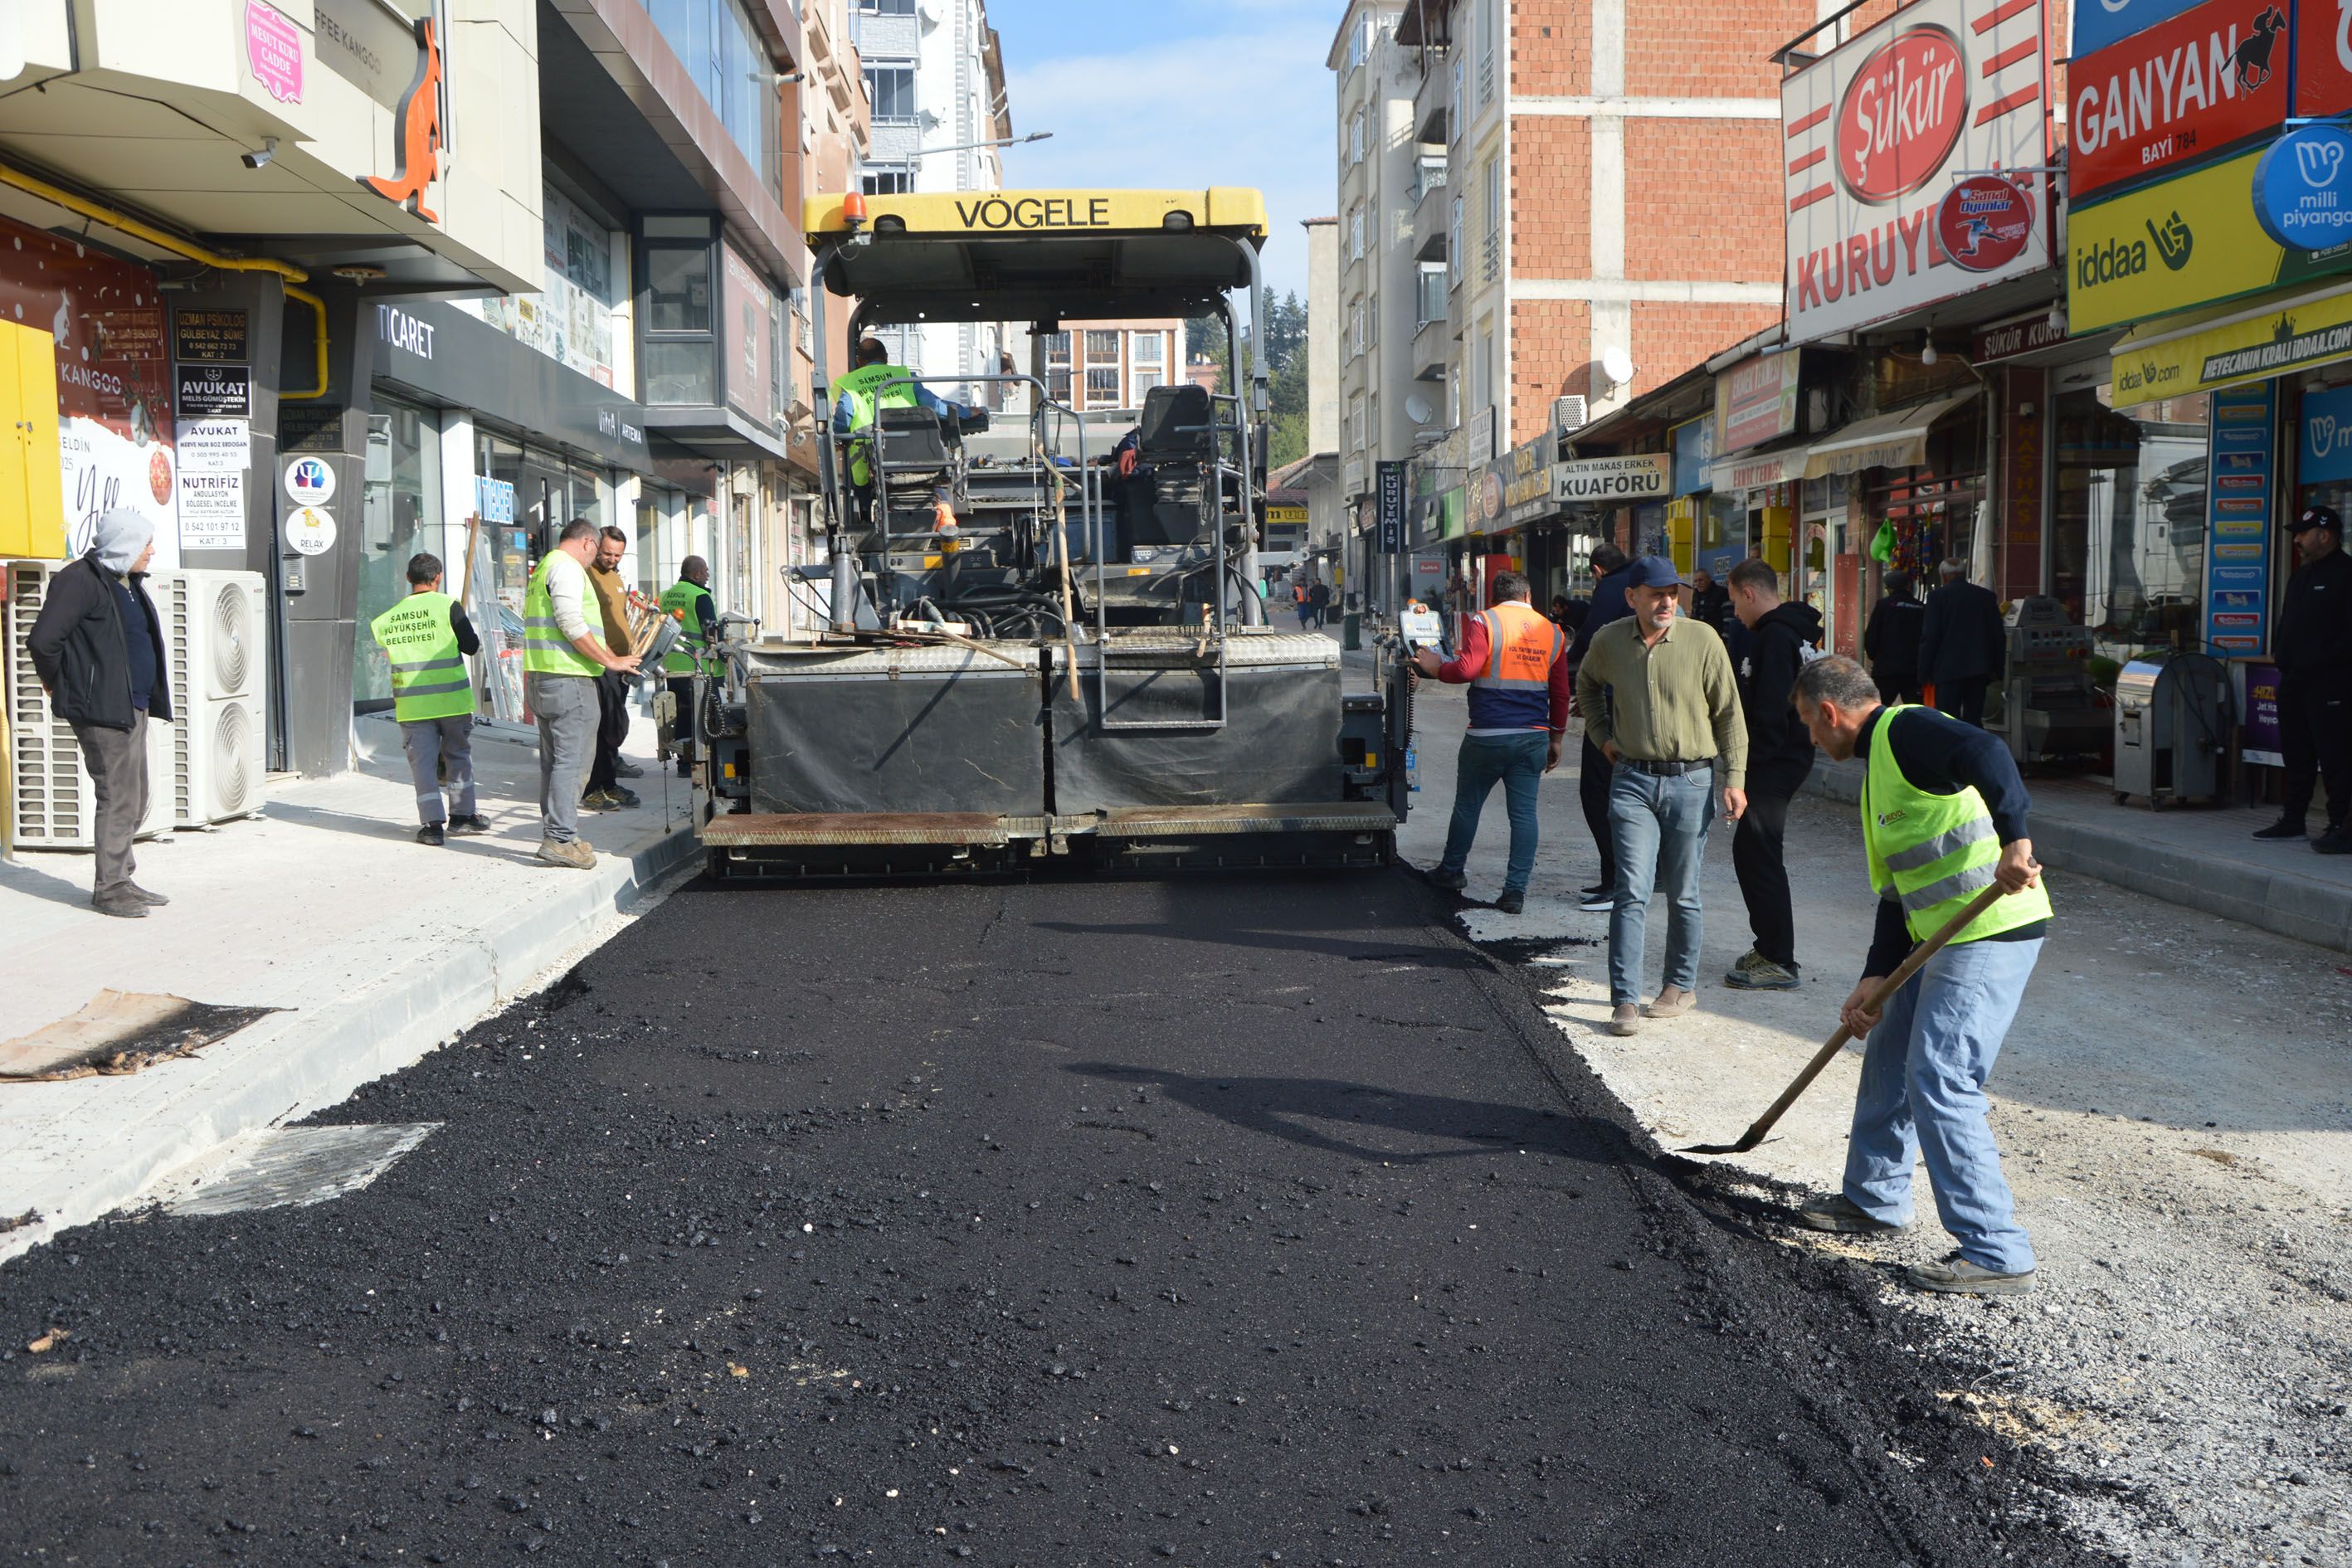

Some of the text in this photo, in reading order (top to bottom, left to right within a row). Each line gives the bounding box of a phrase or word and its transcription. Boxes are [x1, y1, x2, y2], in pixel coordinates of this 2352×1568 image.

[251, 23, 278, 50] MESUT
[279, 39, 299, 63] KURU
[342, 29, 382, 75] KANGOO
[261, 47, 292, 75] CADDE
[2076, 23, 2238, 156] GANYAN
[1854, 46, 1955, 187] Şükür
[2142, 129, 2197, 165] BAYİ 784
[1970, 188, 2009, 202] Sanal
[2300, 191, 2337, 208] milli
[954, 193, 1109, 229] VÖGELE
[1960, 200, 2014, 215] Oyunlar
[2077, 238, 2147, 290] iddaa
[179, 312, 246, 327] UZMAN PSİKOLOG
[180, 327, 245, 340] GÜLBEYAZ SÜME
[1984, 326, 2023, 360] ŞÜKÜR
[61, 362, 121, 396] KANGOO
[2118, 364, 2179, 392] iddaa com
[183, 381, 246, 395] AVUKAT
[182, 394, 246, 404] MELİS GÜMÜŞTEKİN
[191, 426, 238, 436] AVUKAT
[597, 406, 642, 445] VitrA ARTEMA
[59, 436, 90, 453] ELDİN
[1566, 459, 1654, 474] ALTIN MAKAS ERKEK
[183, 474, 239, 489] NUTRİFİZ
[1561, 470, 1660, 496] KUAFÖRÜ
[186, 499, 213, 508] BÖLGESEL
[185, 523, 239, 531] 0 542 101 97 12
[300, 539, 324, 548] RELAX
[390, 608, 429, 624] SAMSUN
[386, 631, 435, 645] BELEDİYESİ
